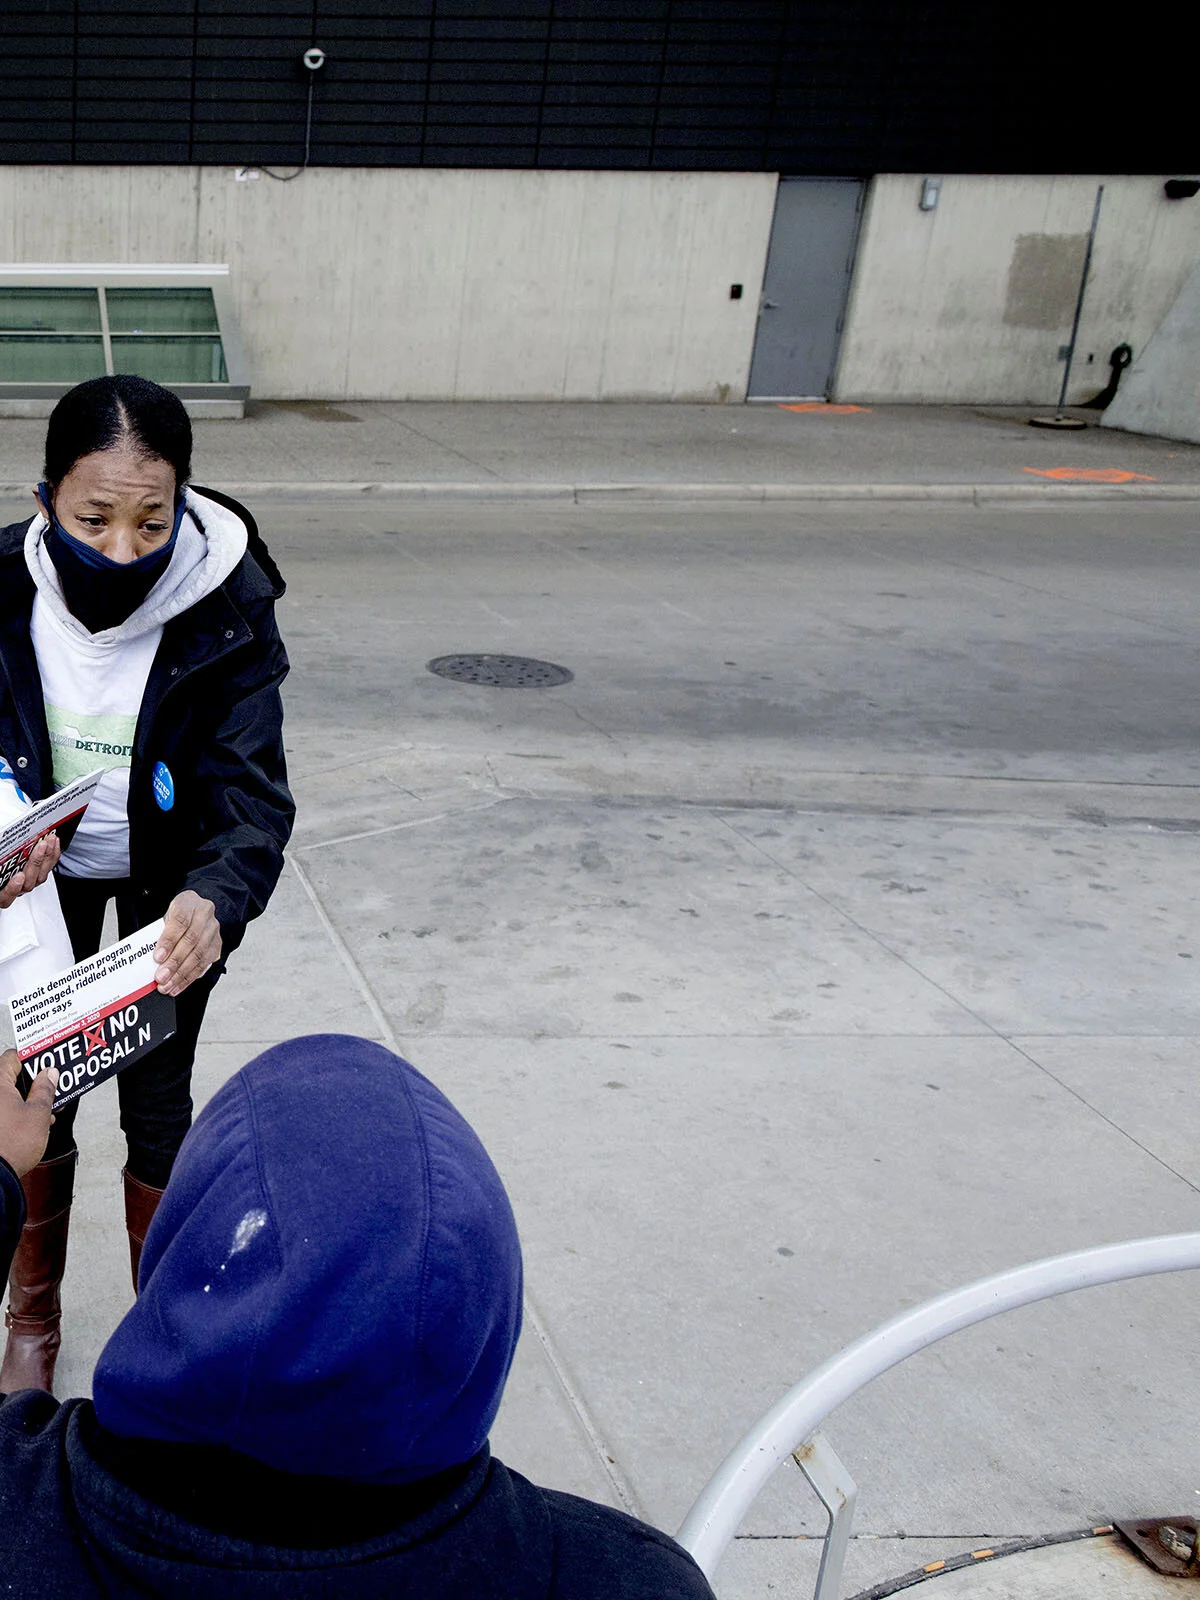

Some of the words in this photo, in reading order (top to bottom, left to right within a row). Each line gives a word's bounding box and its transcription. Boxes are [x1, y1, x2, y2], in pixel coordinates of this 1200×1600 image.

[75, 739, 133, 757] DETROIT
[11, 984, 49, 1009] Detroit
[47, 962, 95, 991] demolition
[96, 943, 132, 969] program
[14, 986, 75, 1022] mismanaged,
[75, 969, 108, 991] riddled
[107, 956, 128, 973] with
[15, 1009, 51, 1033] auditor
[51, 999, 73, 1017] says
[21, 1049, 31, 1057] On
[30, 1037, 54, 1053] Tuesday
[53, 1023, 81, 1042] November
[86, 1011, 101, 1023] 2020
[24, 1036, 82, 1080] VOTE
[109, 1004, 139, 1038] NO
[55, 1036, 135, 1097] OPOSAL
[137, 1022, 151, 1047] N
